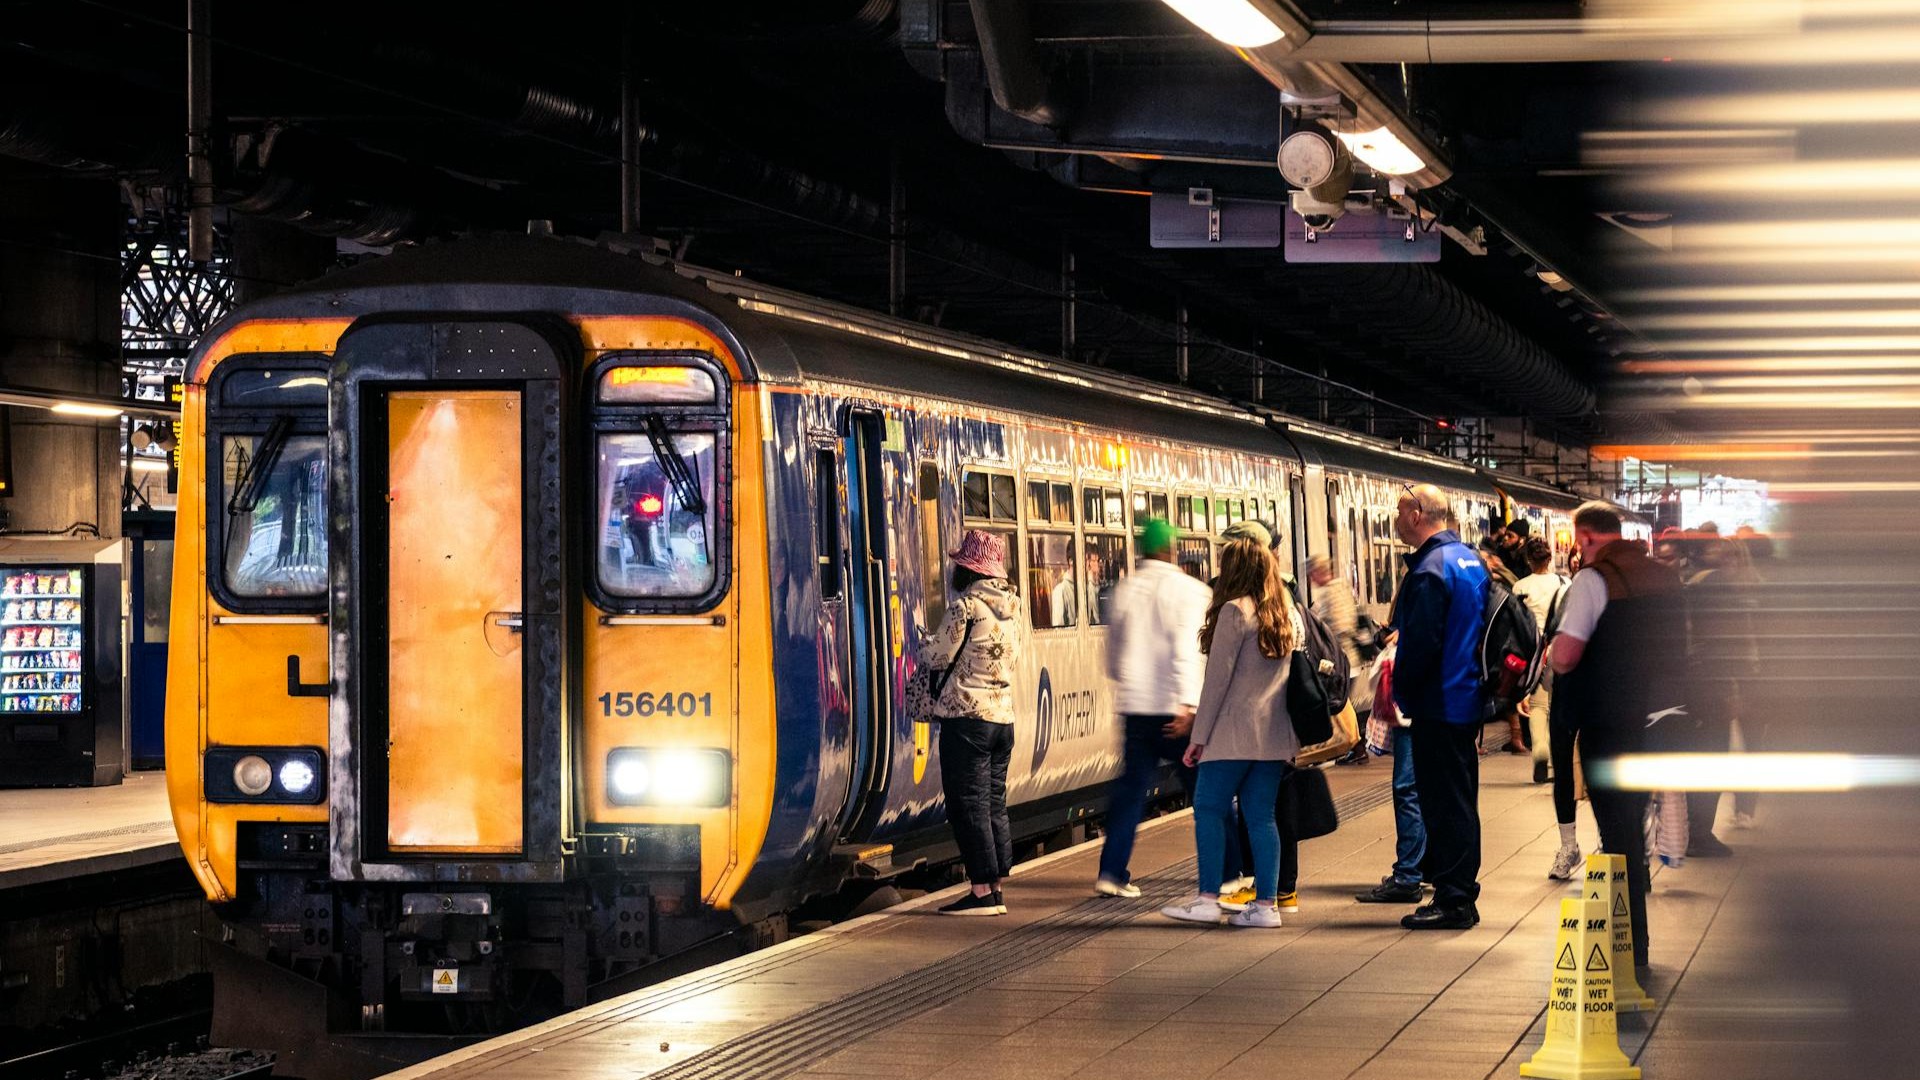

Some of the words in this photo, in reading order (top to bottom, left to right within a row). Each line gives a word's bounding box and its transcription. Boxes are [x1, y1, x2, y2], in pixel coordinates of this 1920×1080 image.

[598, 692, 711, 717] 156401
[1052, 689, 1097, 743] NORTHERN
[1587, 871, 1606, 880] SIR
[1561, 919, 1579, 929] SIR
[1587, 919, 1607, 930] SIR
[1615, 932, 1628, 940] WET
[1613, 943, 1632, 953] FLOOR
[1554, 976, 1577, 985] CAUTION
[1584, 978, 1612, 986] CAUTION
[1557, 987, 1573, 998] WET
[1588, 988, 1608, 999] WET
[1551, 1000, 1577, 1012] FLOOR
[1584, 1002, 1614, 1013] FLOOR
